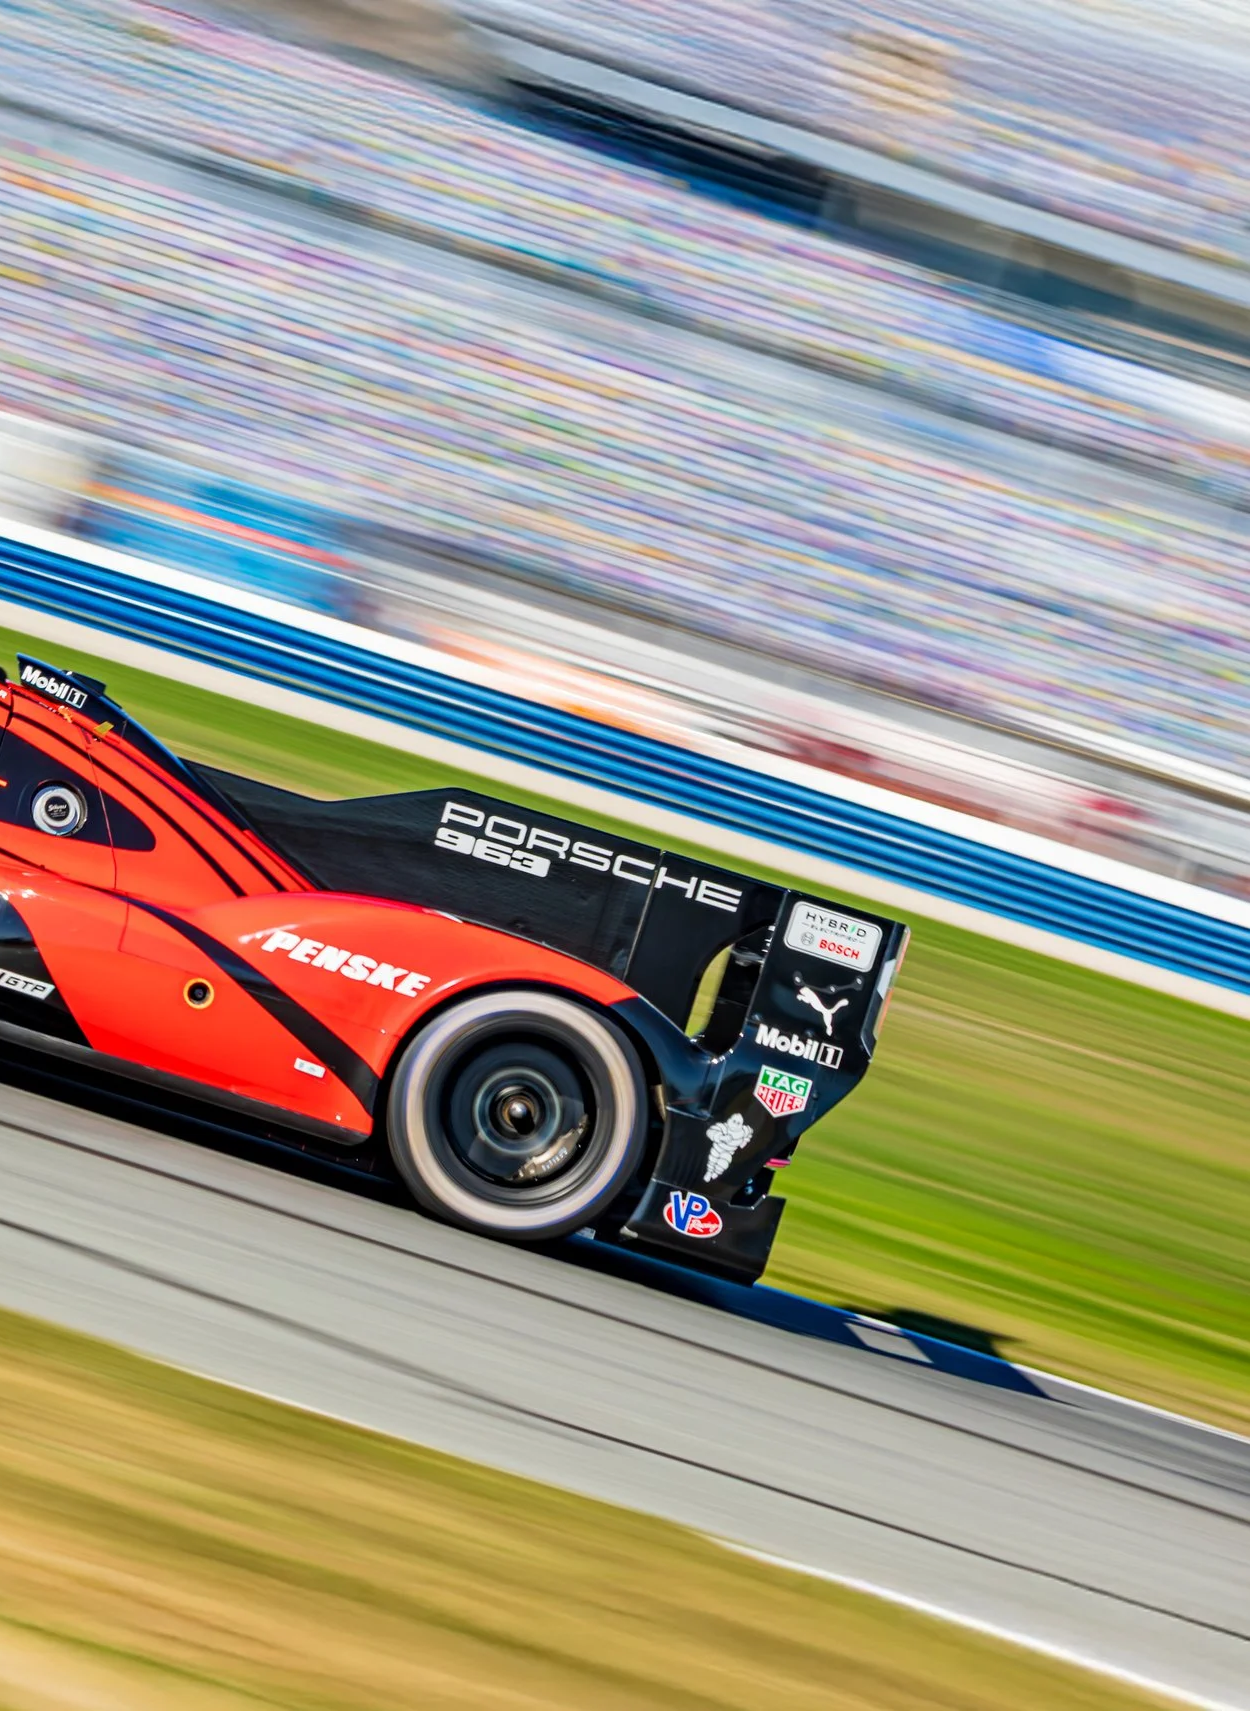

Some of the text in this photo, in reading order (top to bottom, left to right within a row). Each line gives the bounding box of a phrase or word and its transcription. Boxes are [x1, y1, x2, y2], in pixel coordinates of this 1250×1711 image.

[21, 665, 67, 700] Mobil
[433, 826, 552, 879] 963
[439, 800, 743, 913] PORSCHE
[260, 929, 433, 998] PENSKE
[819, 939, 860, 960] BOSCH
[5, 977, 46, 995] GTP
[755, 1024, 843, 1069] Mobil 1
[756, 1086, 808, 1117] HEUER
[765, 1070, 807, 1096] TAG
[672, 1193, 710, 1232] VP
